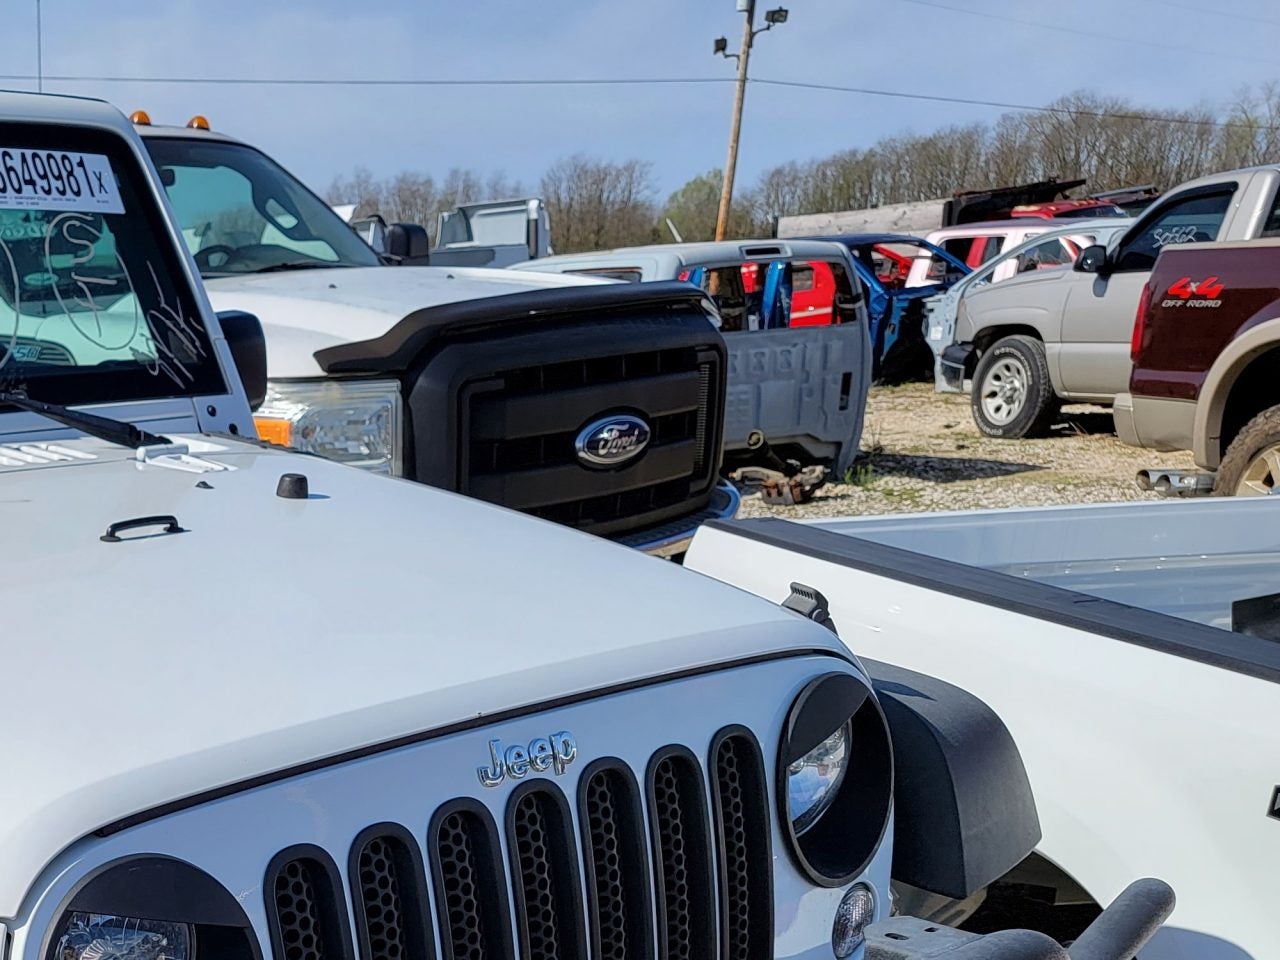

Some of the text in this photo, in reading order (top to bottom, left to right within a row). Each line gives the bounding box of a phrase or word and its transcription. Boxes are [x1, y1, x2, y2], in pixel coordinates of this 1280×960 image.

[1161, 299, 1222, 308] OFF ROAD
[597, 423, 639, 456] Ford
[477, 730, 578, 788] Jeep
